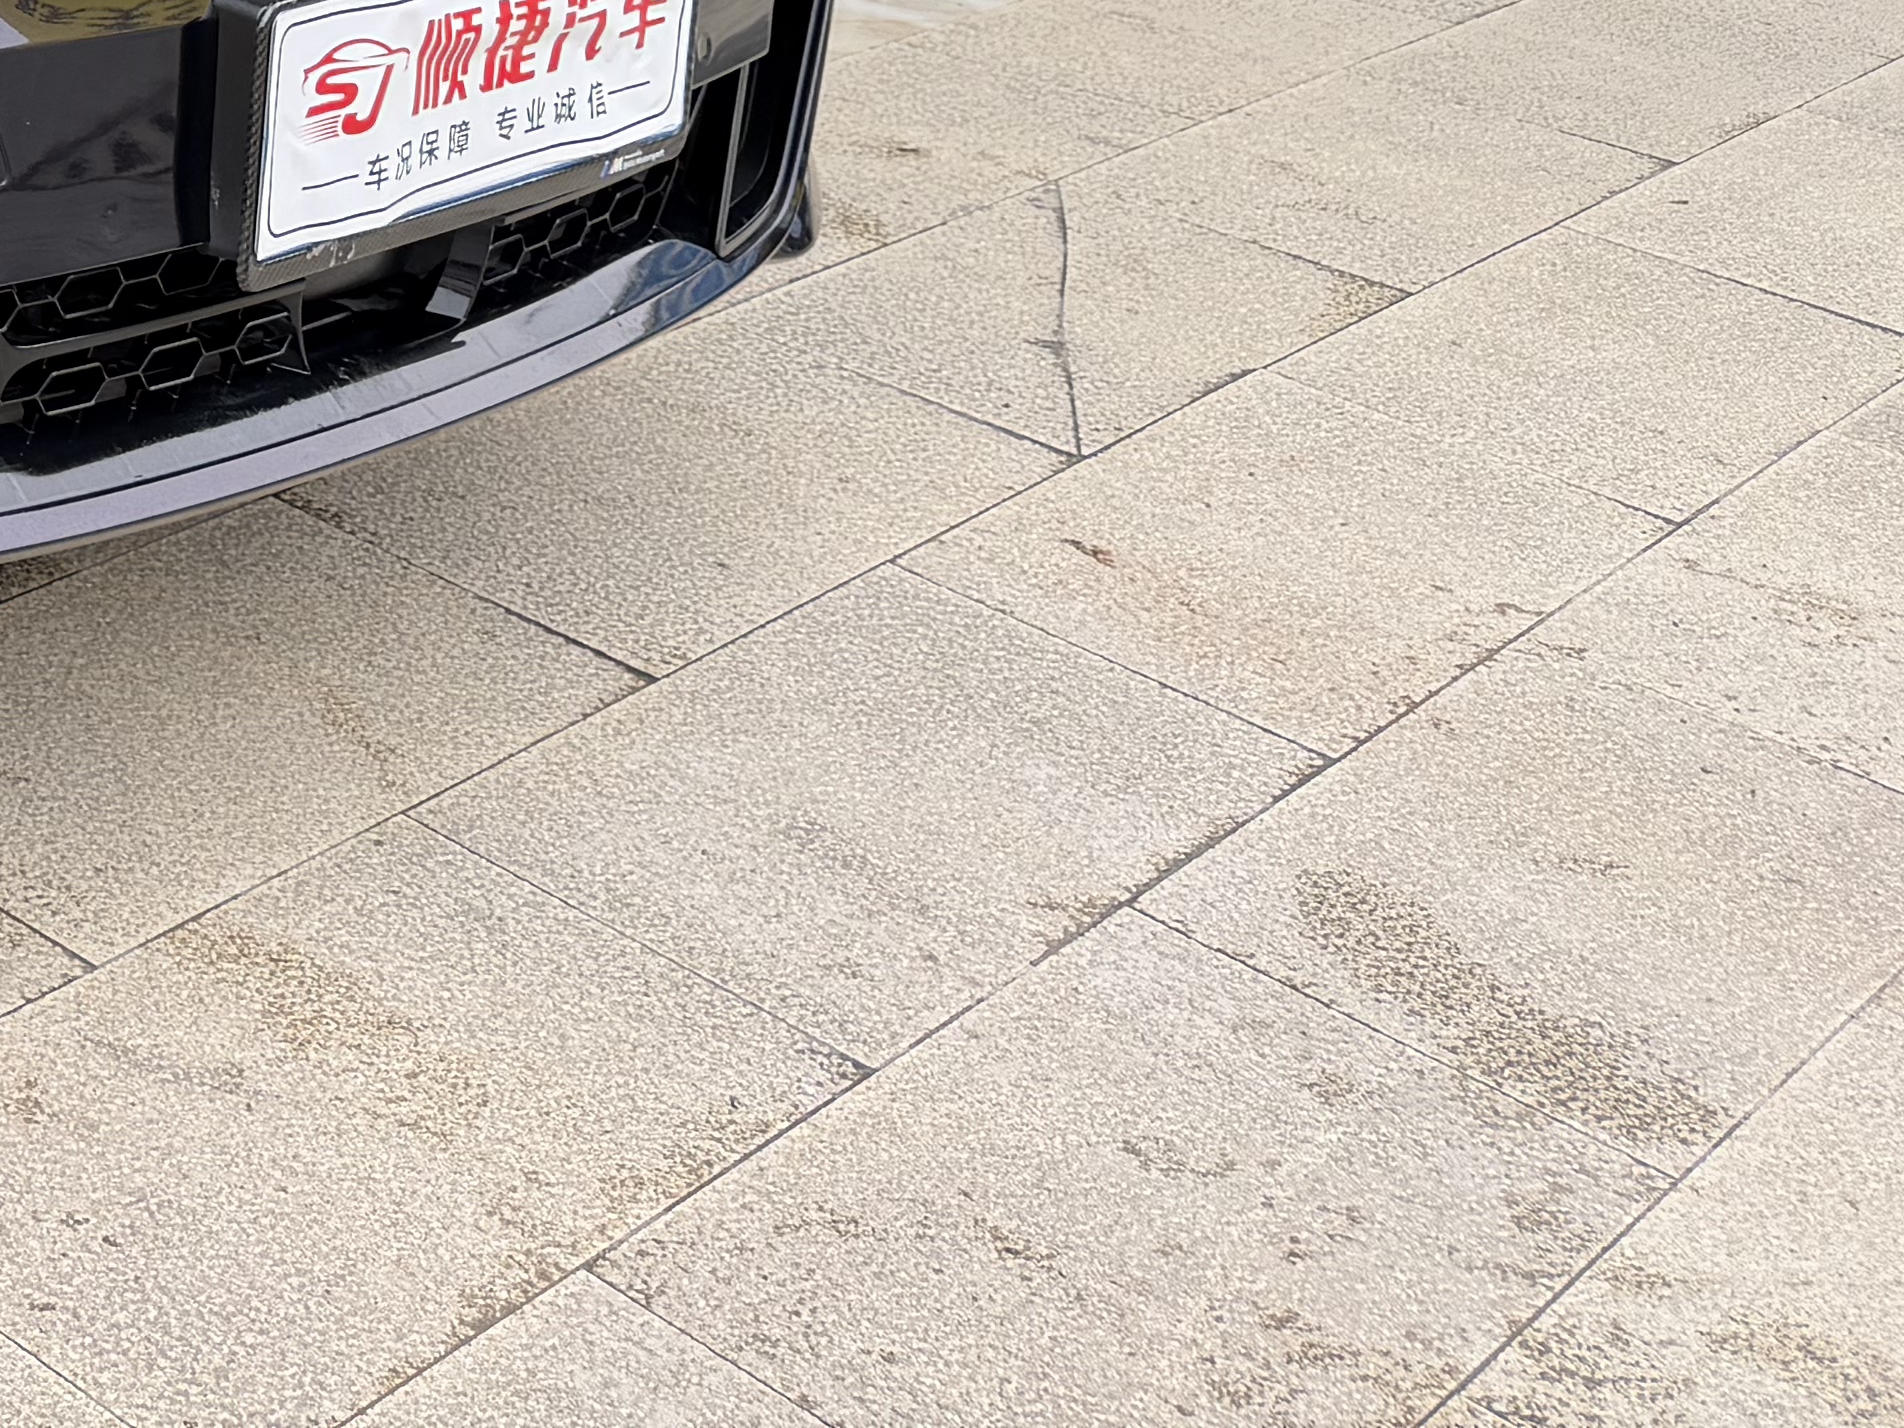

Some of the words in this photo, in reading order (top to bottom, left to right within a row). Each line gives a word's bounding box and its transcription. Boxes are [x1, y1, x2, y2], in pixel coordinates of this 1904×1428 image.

[365, 120, 472, 192] 车况保障
[495, 80, 610, 142] 专业诚信
